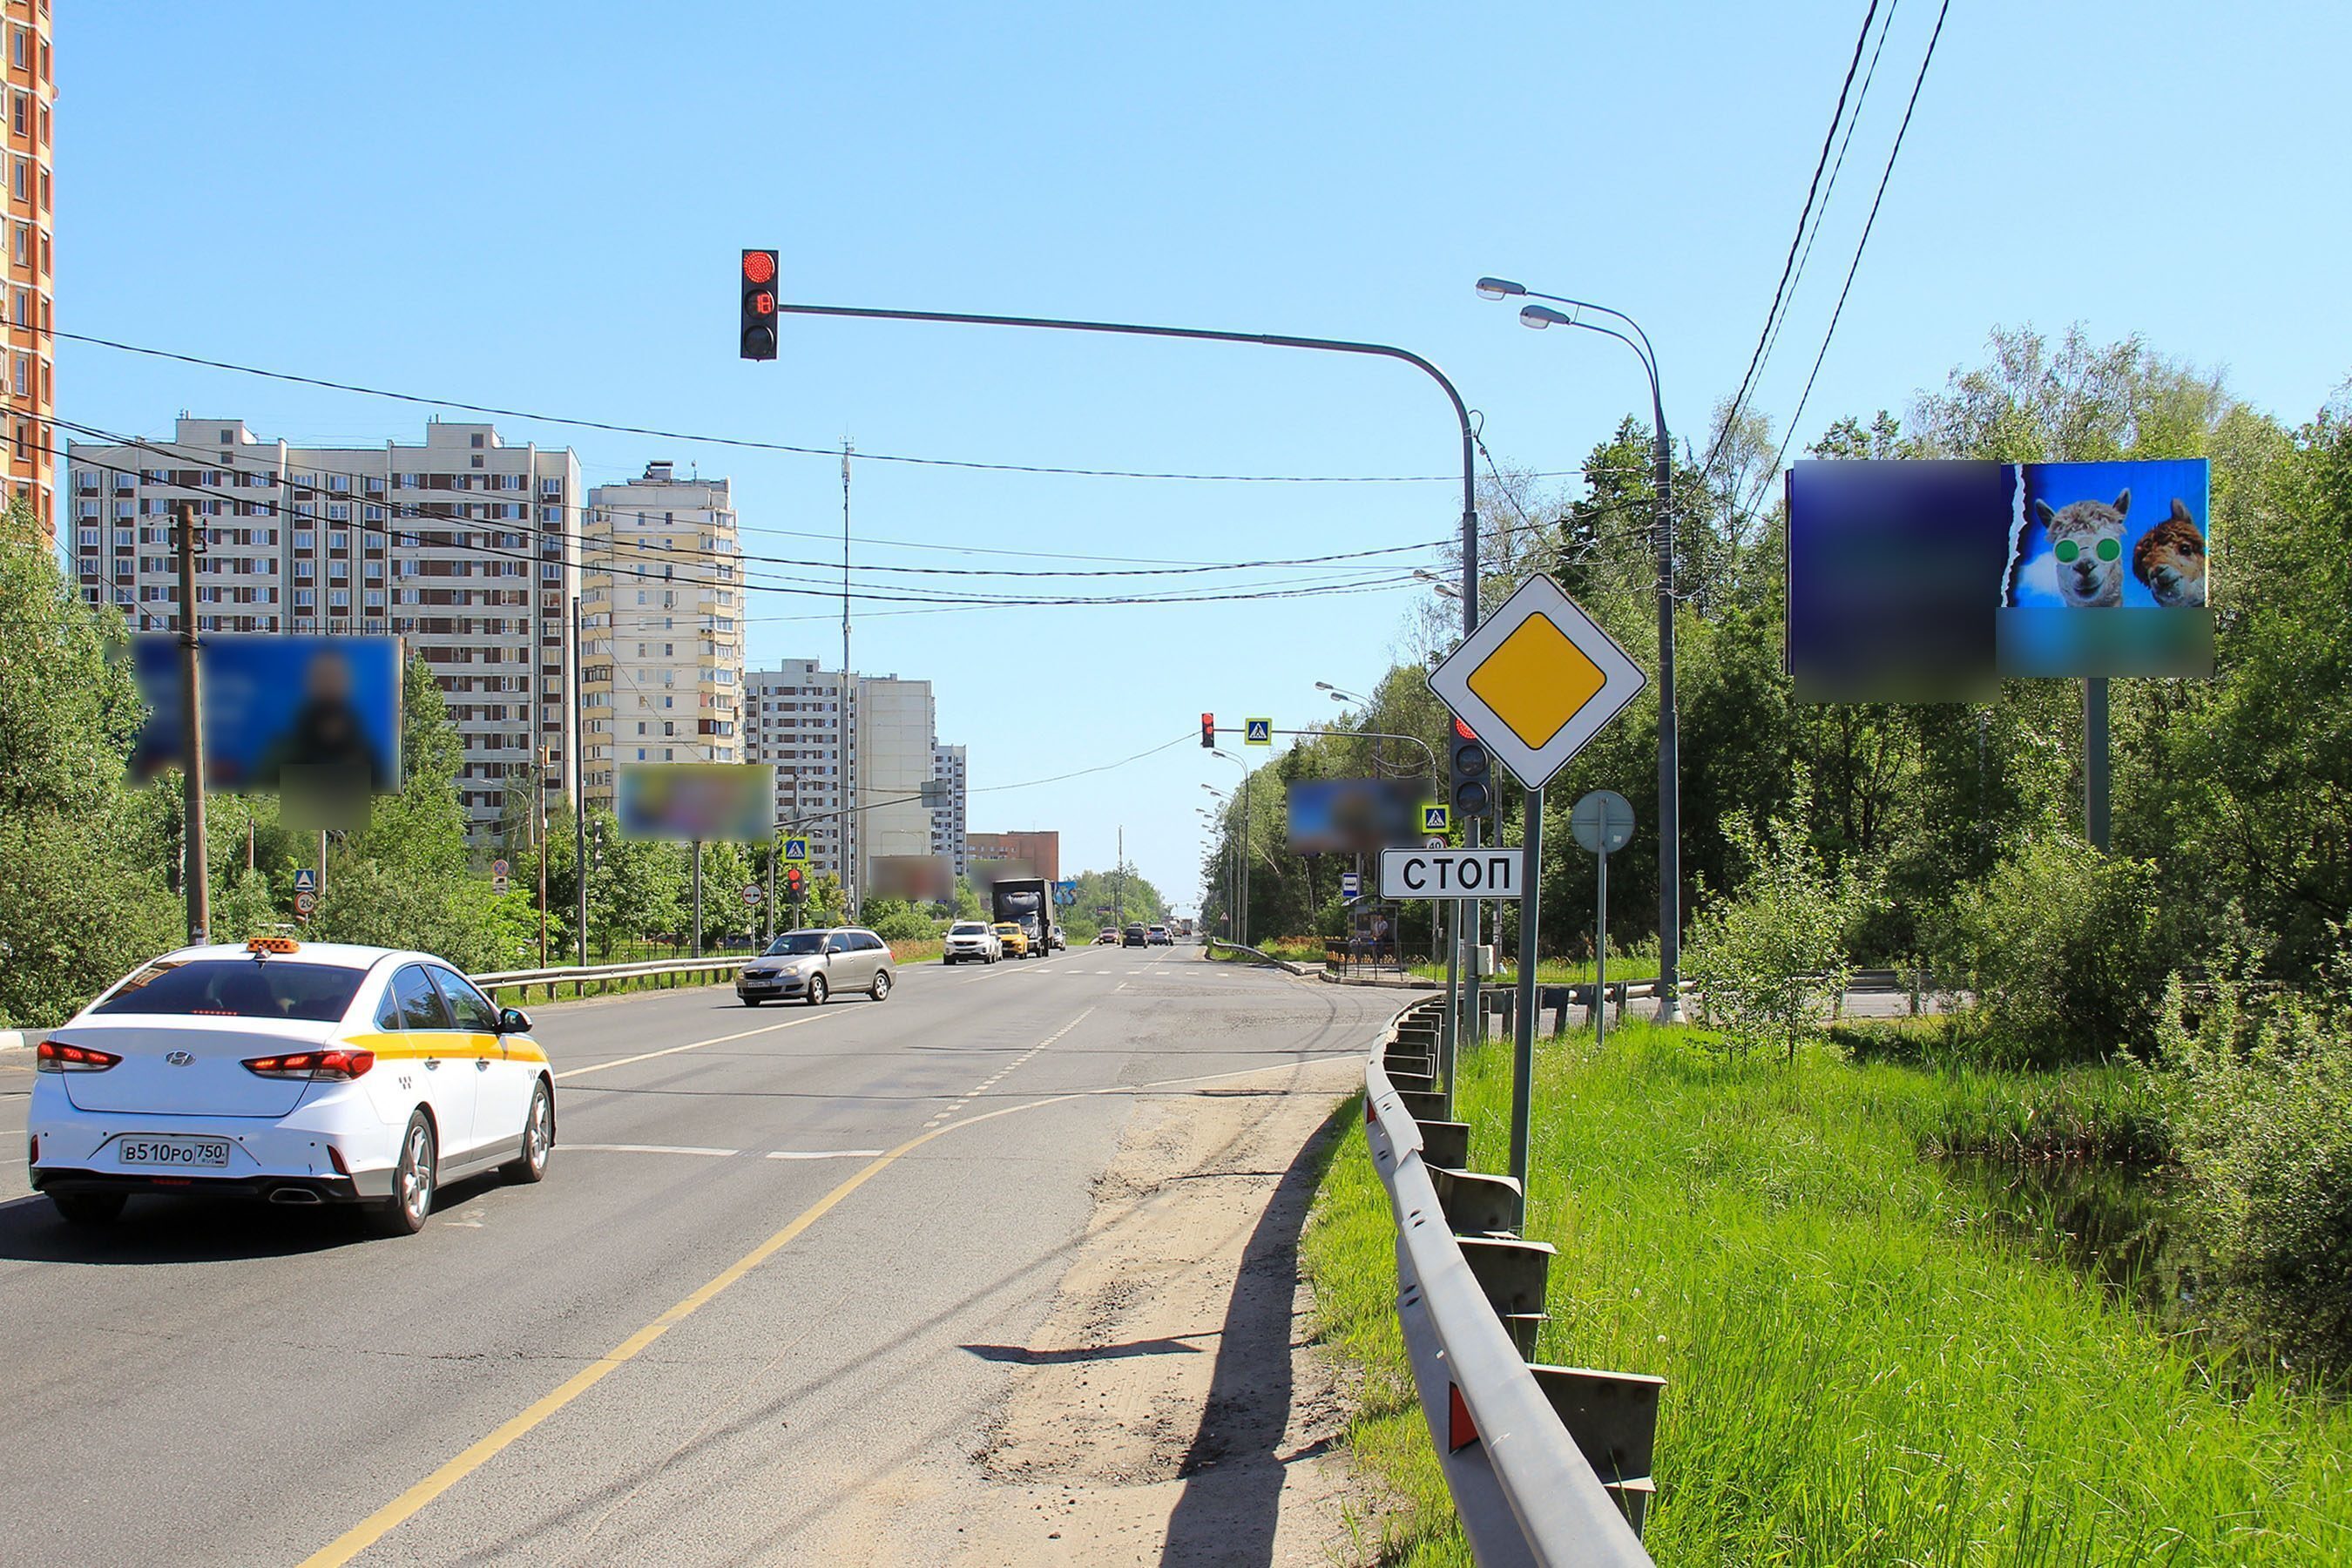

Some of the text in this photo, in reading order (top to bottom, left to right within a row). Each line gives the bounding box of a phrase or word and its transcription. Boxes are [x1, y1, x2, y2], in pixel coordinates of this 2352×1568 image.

[1403, 858, 1510, 889] СТОП
[126, 1143, 222, 1162] В510РО 750
